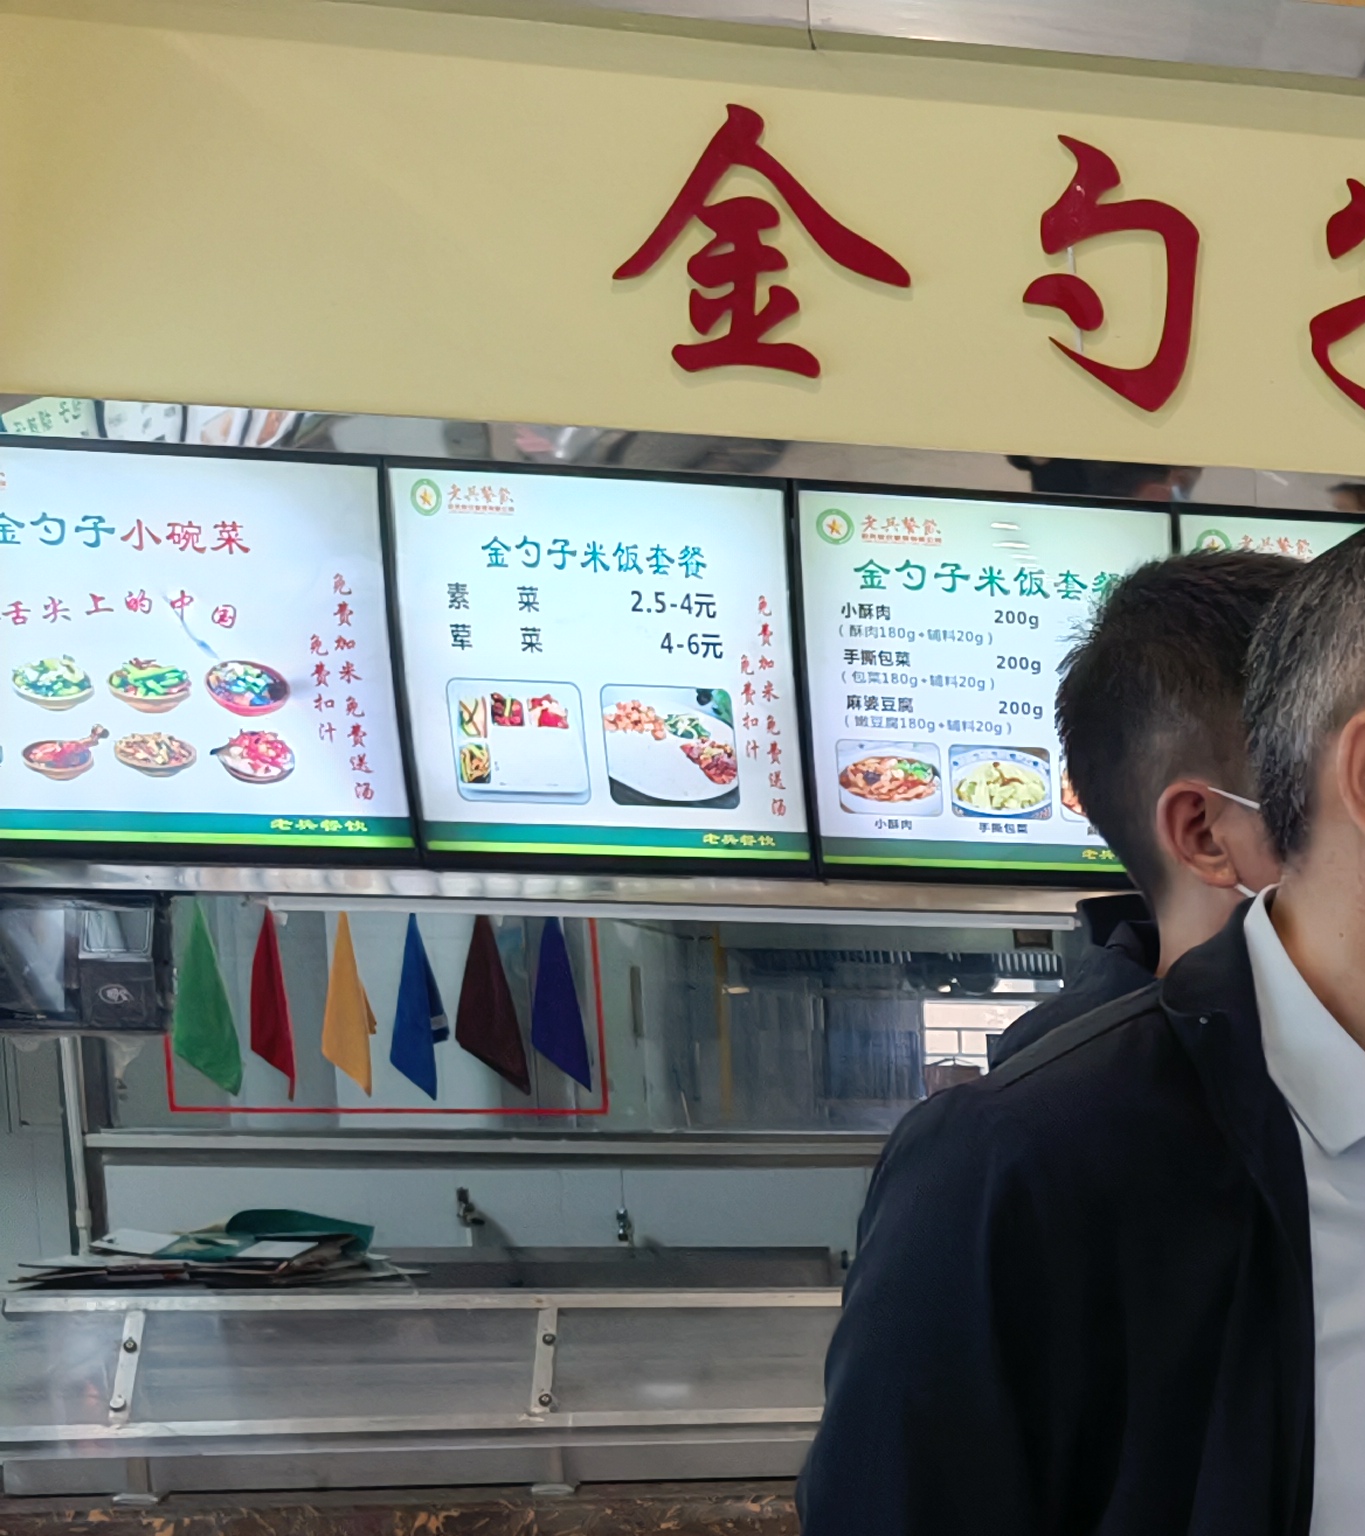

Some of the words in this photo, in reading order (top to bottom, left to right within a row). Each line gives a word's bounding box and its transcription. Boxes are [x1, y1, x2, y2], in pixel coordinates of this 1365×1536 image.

[0, 511, 251, 555] 金勺子小碗菜
[481, 535, 708, 580] 金勺子米饭套餐
[8, 588, 238, 629] 舌尖上的中国
[446, 582, 470, 610] 素
[516, 585, 540, 613] 菜
[630, 590, 717, 618] 2.5-4元
[840, 602, 891, 622] 小酥肉
[993, 609, 1040, 629] 200g
[449, 623, 473, 651] 荤
[520, 627, 544, 653] 菜
[659, 632, 724, 659] 4-6元
[843, 648, 911, 668] 手撕包菜
[996, 655, 1042, 675] 200g
[333, 573, 374, 801] 免费加米免费送汤
[757, 594, 787, 817] 免费加米免费送汤
[846, 694, 914, 714] 麻婆豆腐
[998, 700, 1044, 720] 200g
